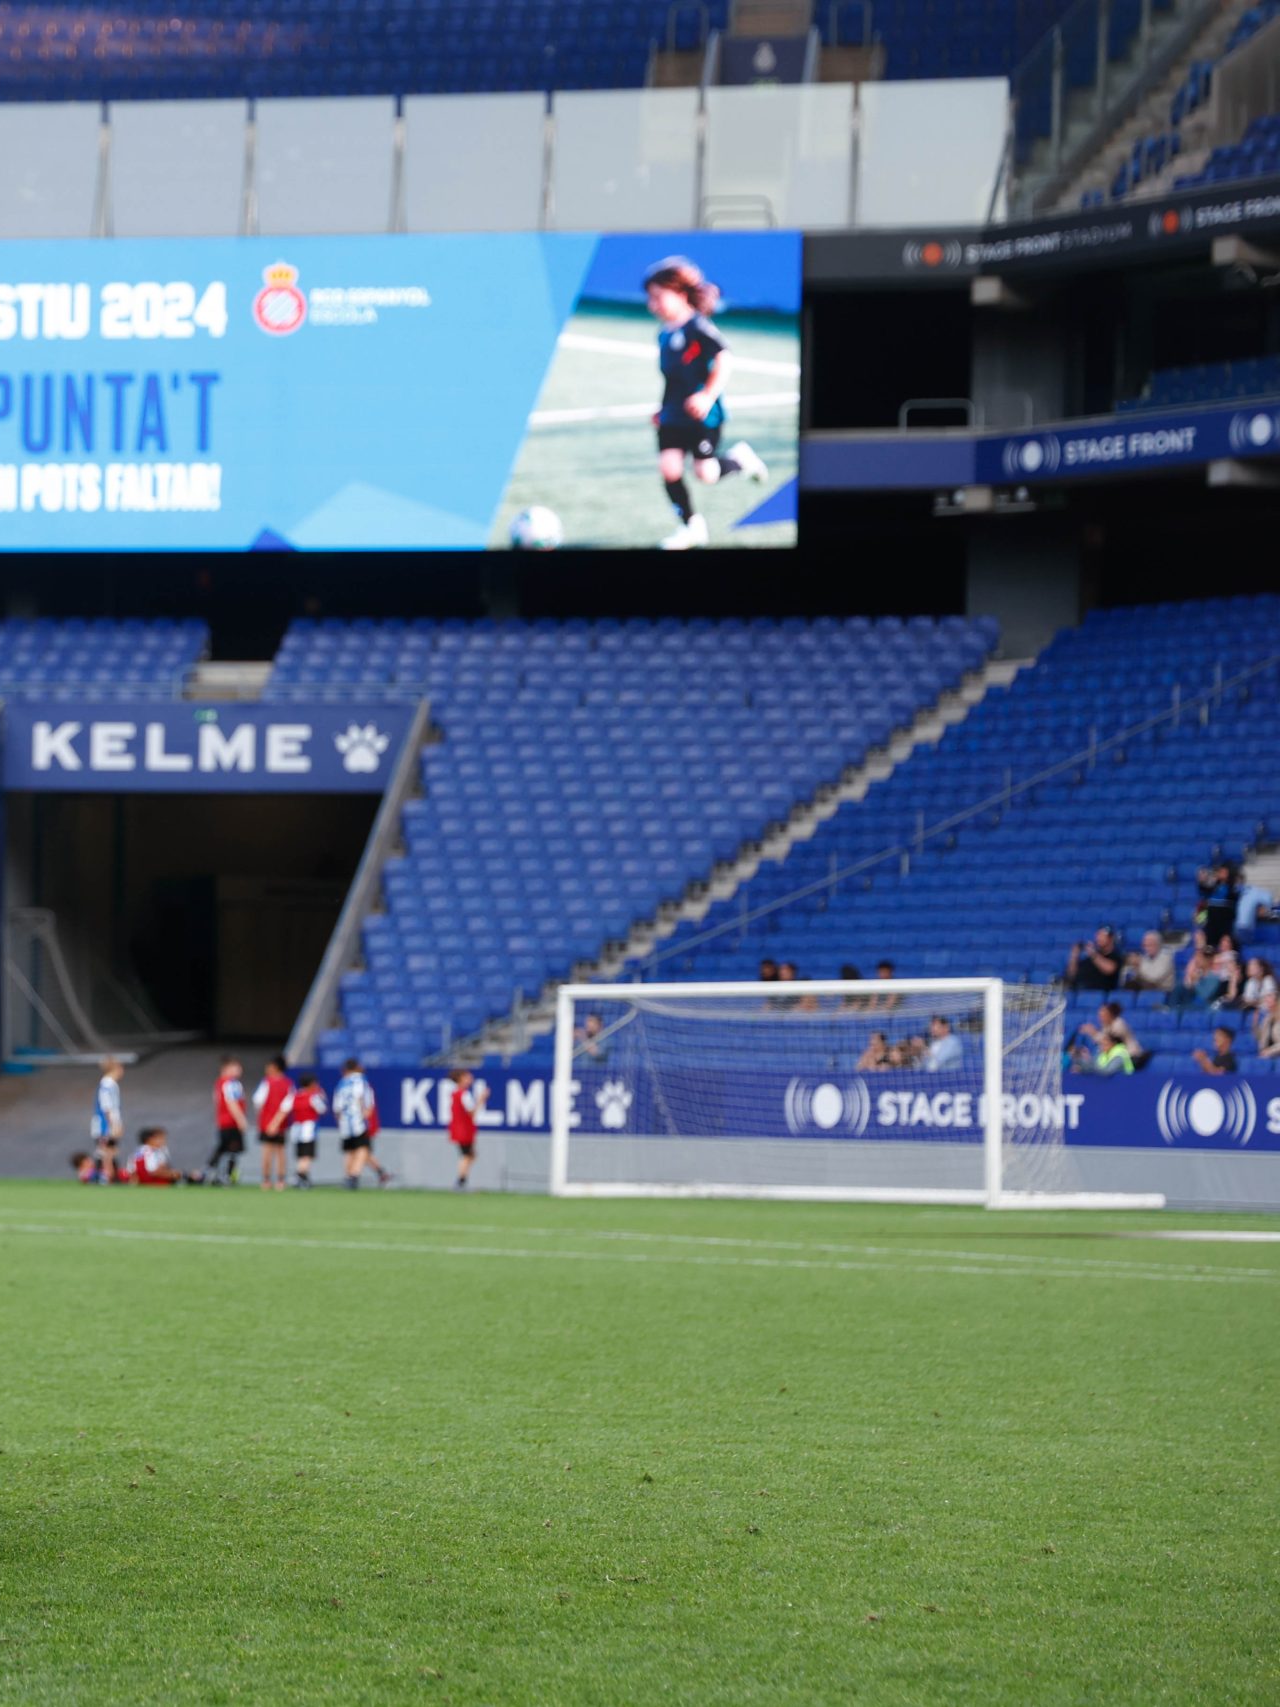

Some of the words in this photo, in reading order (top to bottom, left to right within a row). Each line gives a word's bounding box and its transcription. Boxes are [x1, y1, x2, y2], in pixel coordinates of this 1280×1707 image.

[100, 281, 228, 339] 2024
[1064, 434, 1126, 465] STAGE
[1128, 426, 1197, 458] FRONT
[20, 462, 102, 513] POTS
[31, 721, 313, 774] KELME
[877, 1091, 972, 1128] STAGE
[980, 1094, 1085, 1130] RONT
